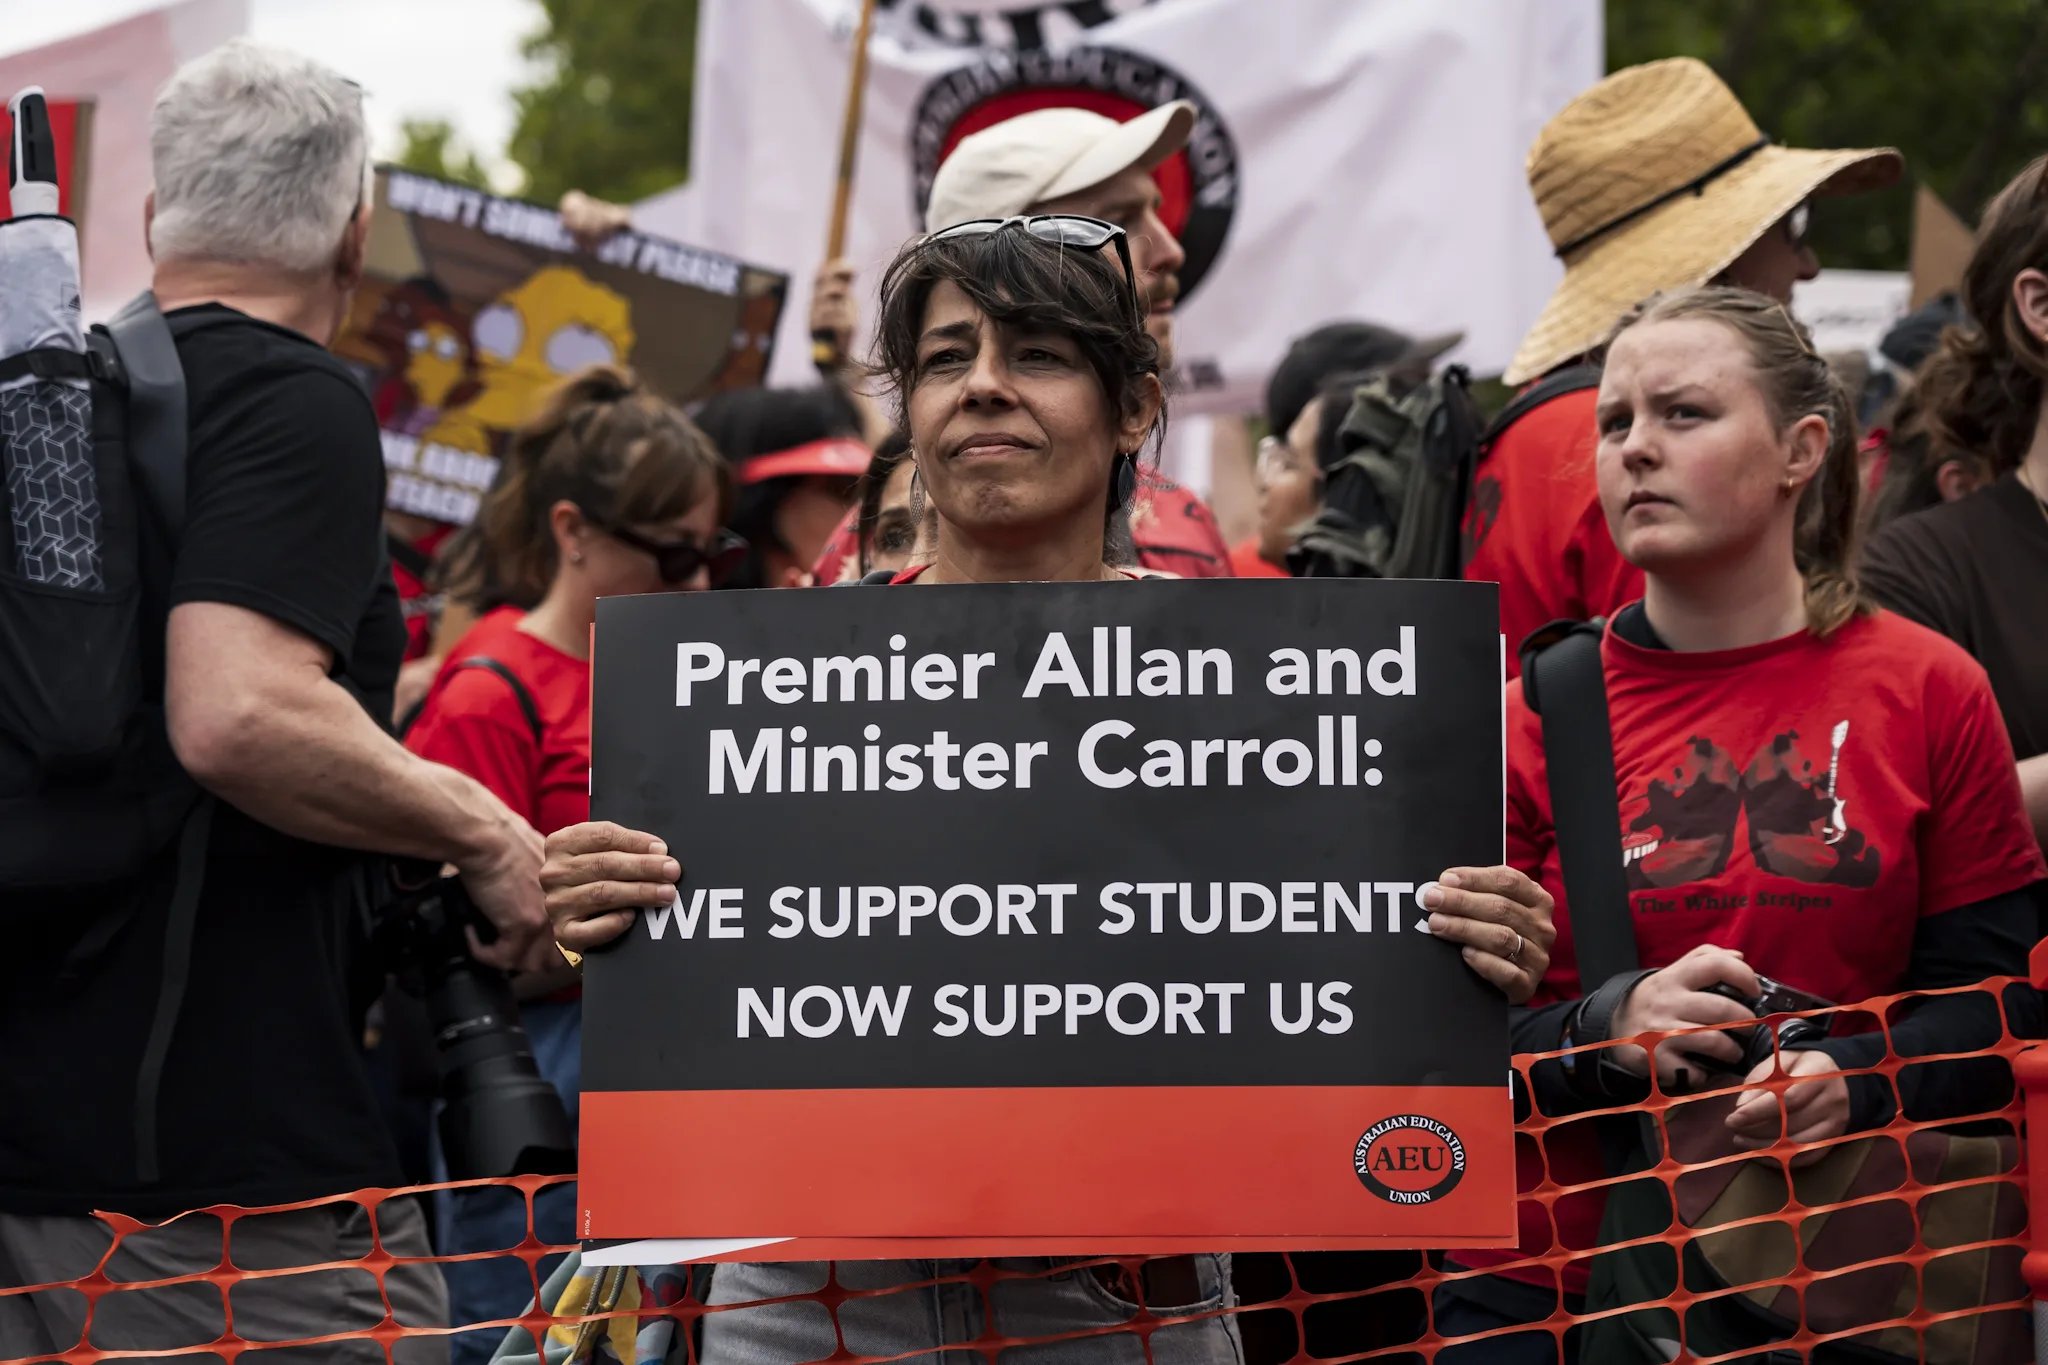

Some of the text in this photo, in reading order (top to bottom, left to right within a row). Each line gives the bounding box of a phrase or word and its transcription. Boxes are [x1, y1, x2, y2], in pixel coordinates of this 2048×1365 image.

[676, 626, 1417, 706] Premier Allan and
[709, 715, 1383, 794] Minister Carroll:
[643, 888, 745, 940] WE
[768, 884, 1077, 939] SUPPORT
[1637, 891, 1833, 914] The White Stripes
[737, 981, 1353, 1039] NOW SUPPORT US
[1355, 1116, 1465, 1174] AUSTRALIAN EDUCATION
[1372, 1146, 1446, 1172] AEU
[1389, 1190, 1432, 1204] UNION
